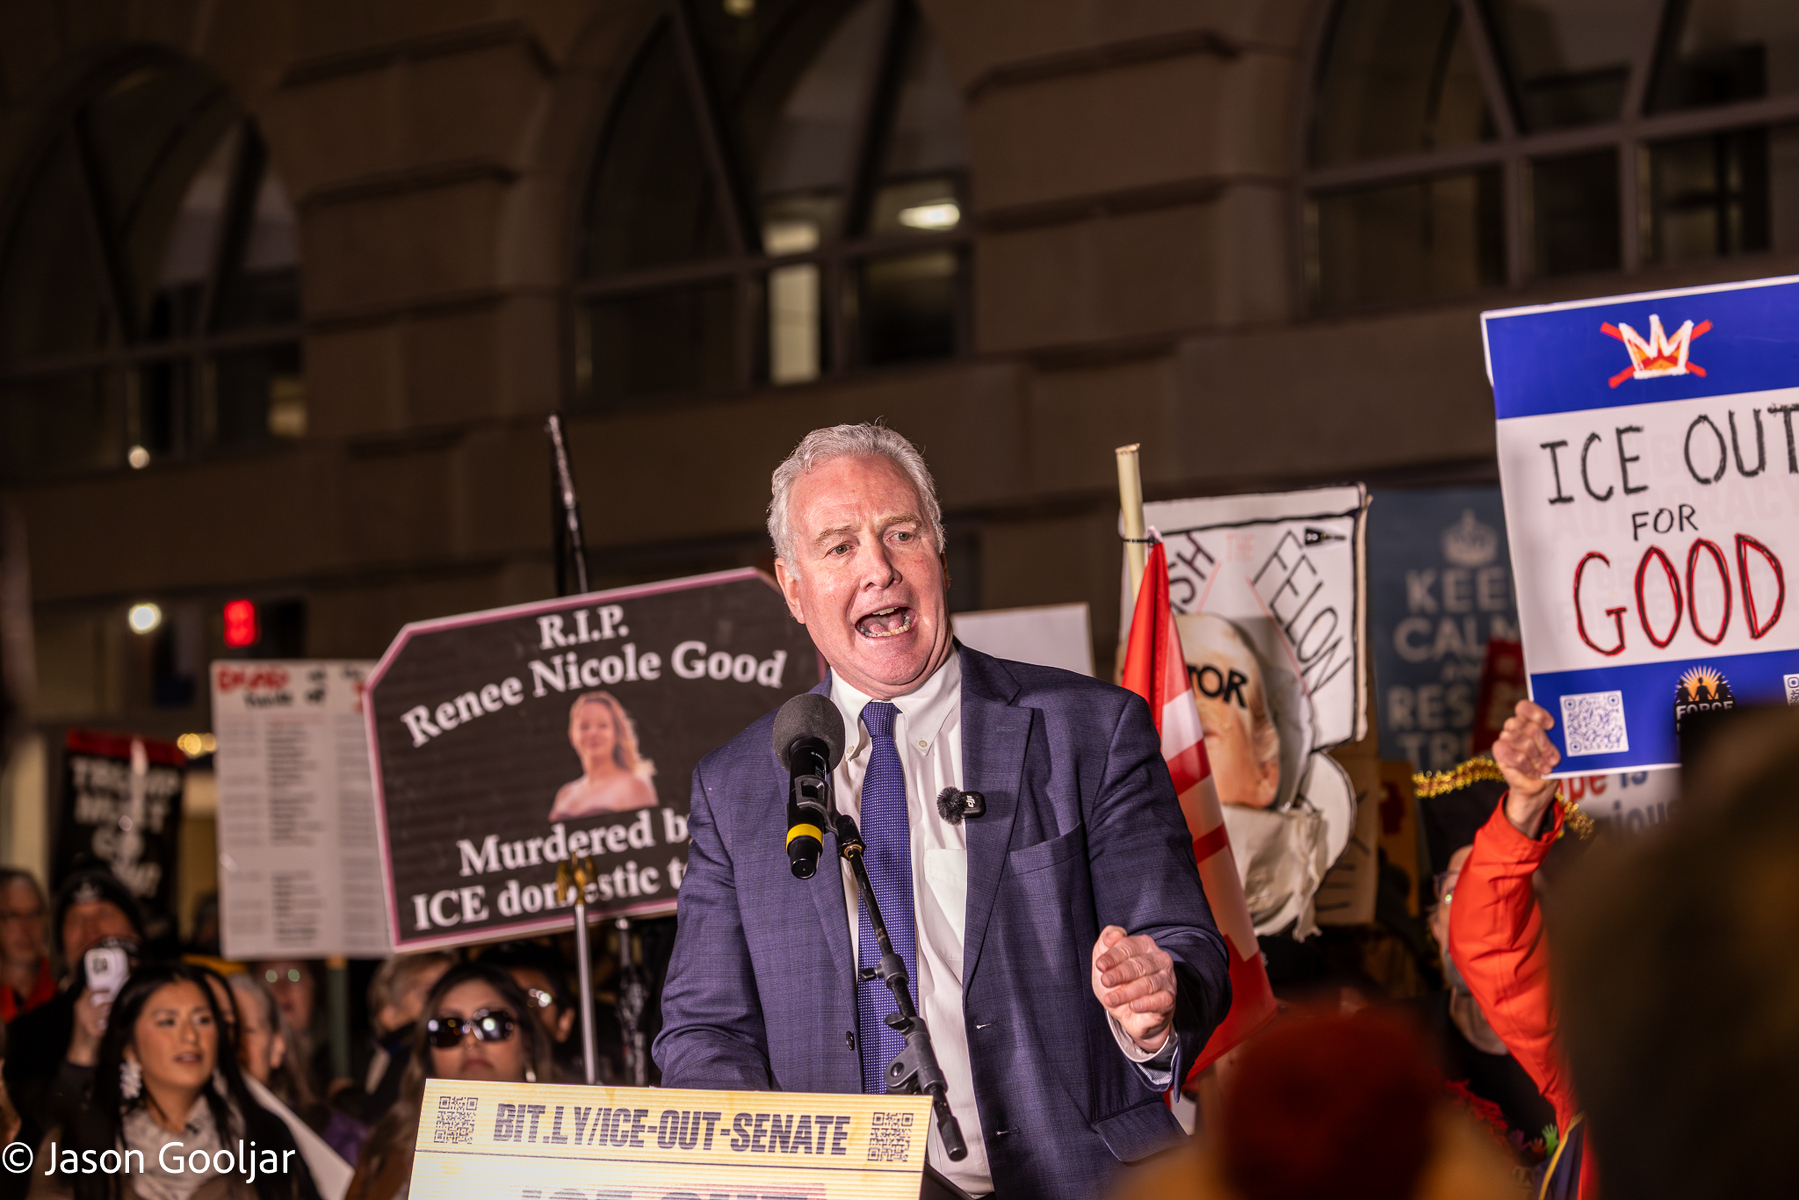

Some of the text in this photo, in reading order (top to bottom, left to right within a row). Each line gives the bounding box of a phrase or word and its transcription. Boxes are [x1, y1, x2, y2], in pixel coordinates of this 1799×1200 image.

[1539, 424, 1649, 505] ICE
[1684, 402, 1799, 485] OUT
[1632, 503, 1699, 542] FOR
[536, 604, 630, 651] R.I.P.
[1252, 529, 1352, 697] FELON
[1404, 567, 1516, 615] KEE
[1573, 532, 1785, 657] GOOD
[400, 640, 788, 749] Renee Nicole Good
[455, 806, 692, 878] Murdered b
[410, 884, 490, 932] ICE
[665, 855, 688, 891] t
[492, 1102, 851, 1156] BIT.LY/ICE-OUT-SENATE
